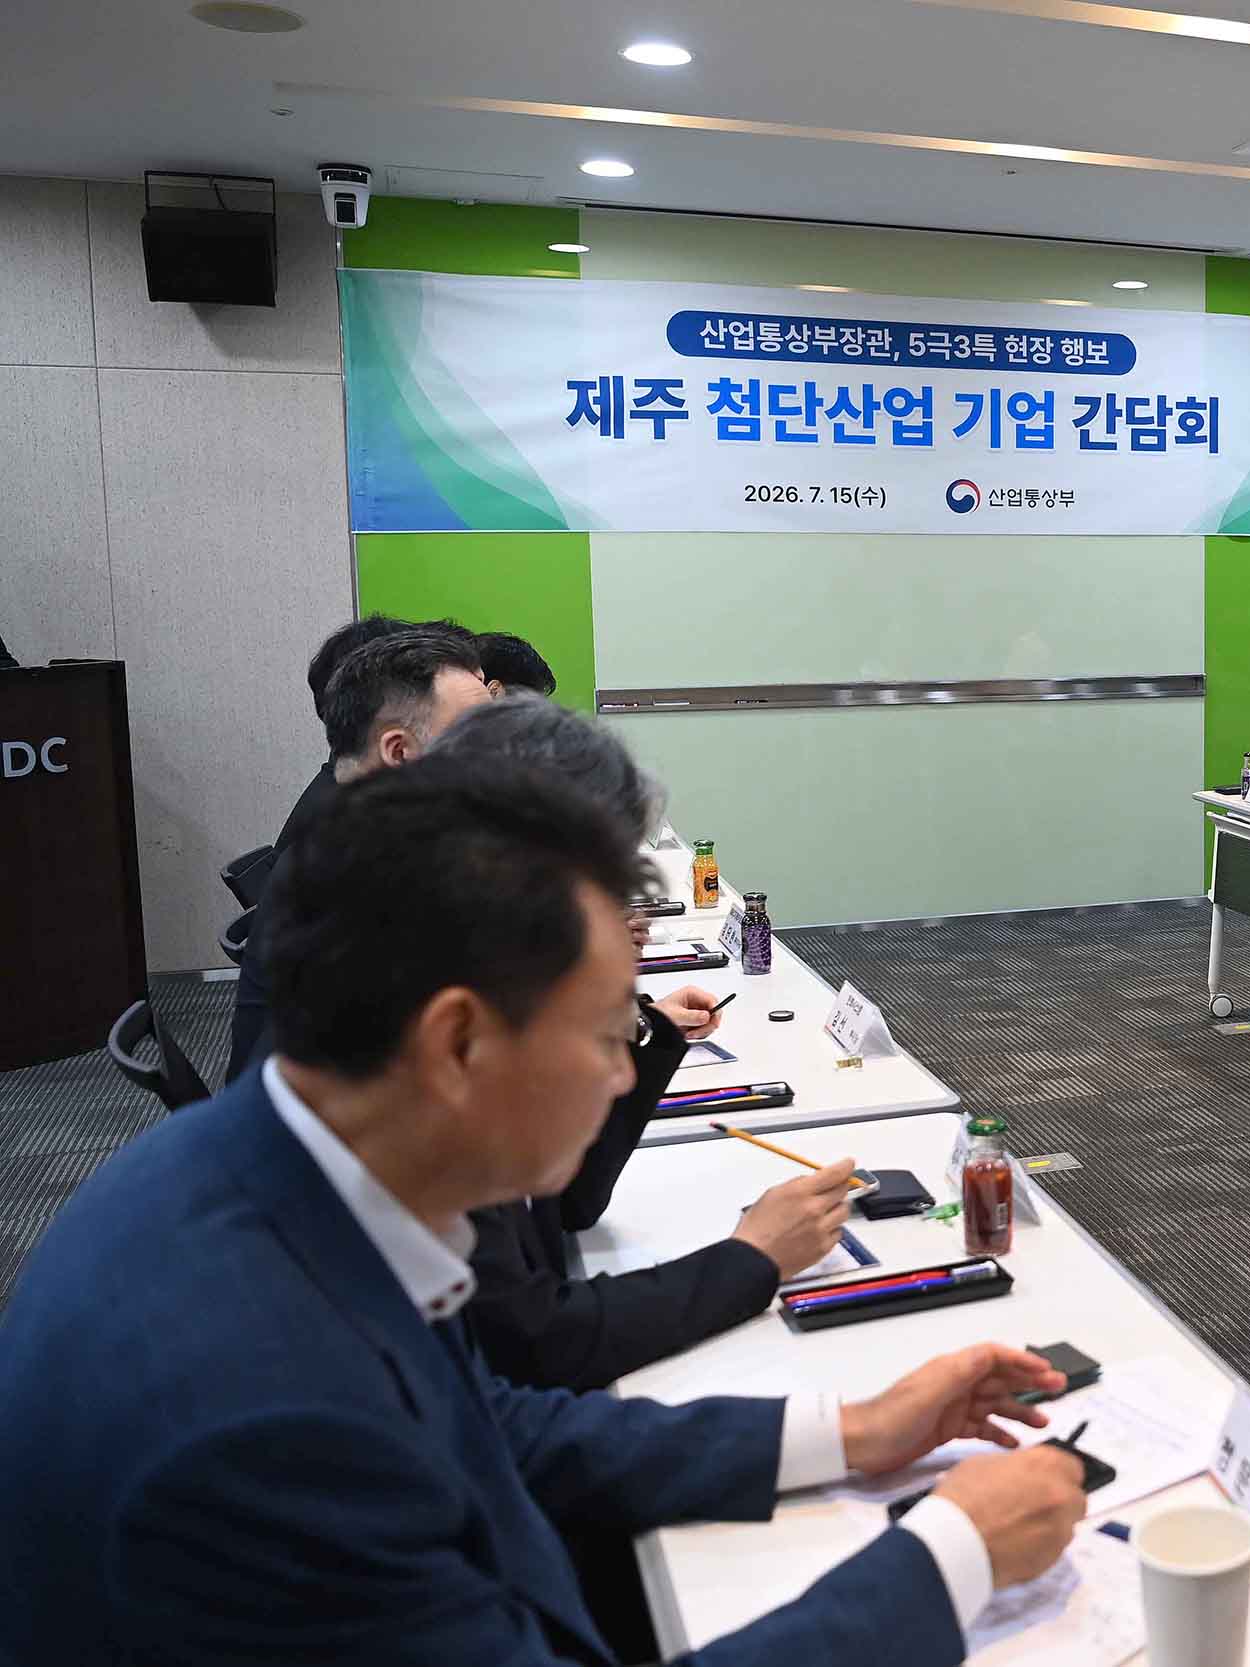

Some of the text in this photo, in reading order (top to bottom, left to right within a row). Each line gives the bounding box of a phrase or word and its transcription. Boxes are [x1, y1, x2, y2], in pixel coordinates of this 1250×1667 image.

[700, 318, 1111, 366] 산업통상부장관, 5극3특 현장 행보
[565, 374, 1220, 455] 제주 첨단산업 기업 간담회
[744, 485, 887, 509] 2026. 7. 15(수)
[987, 488, 1076, 509] 산업통상부
